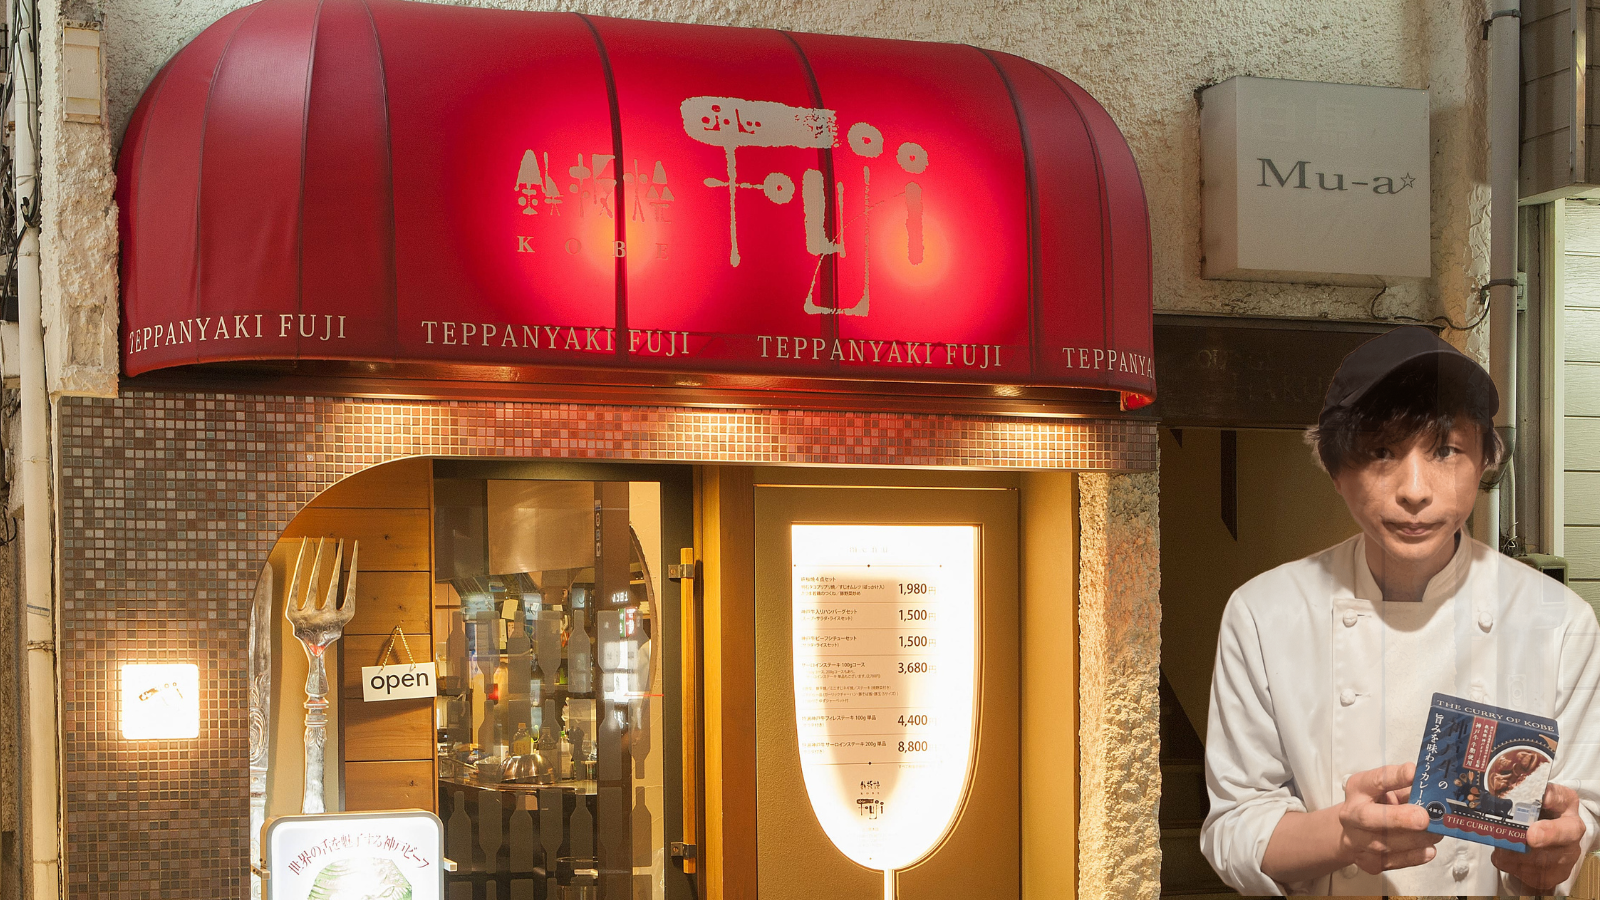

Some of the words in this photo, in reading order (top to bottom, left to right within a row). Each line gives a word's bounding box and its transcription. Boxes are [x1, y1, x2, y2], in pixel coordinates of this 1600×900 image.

[128, 314, 263, 355] TEPPANYAKI
[278, 313, 348, 342] FUJI
[421, 320, 615, 352] TEPPANYAKI
[627, 328, 691, 357] FUJI
[757, 334, 934, 366] TEPPANYAKI
[945, 343, 1003, 368] FUJI
[1062, 347, 1155, 379] TEPPANYA
[370, 669, 430, 695] open
[1436, 699, 1461, 712] THE
[1464, 706, 1504, 721] CURRY
[1506, 716, 1521, 725] OF
[1524, 720, 1556, 733] KOBE
[1446, 815, 1465, 826] THE
[1466, 820, 1495, 832] CURRY
[1495, 827, 1507, 835] OF
[1508, 830, 1527, 840] KOB
